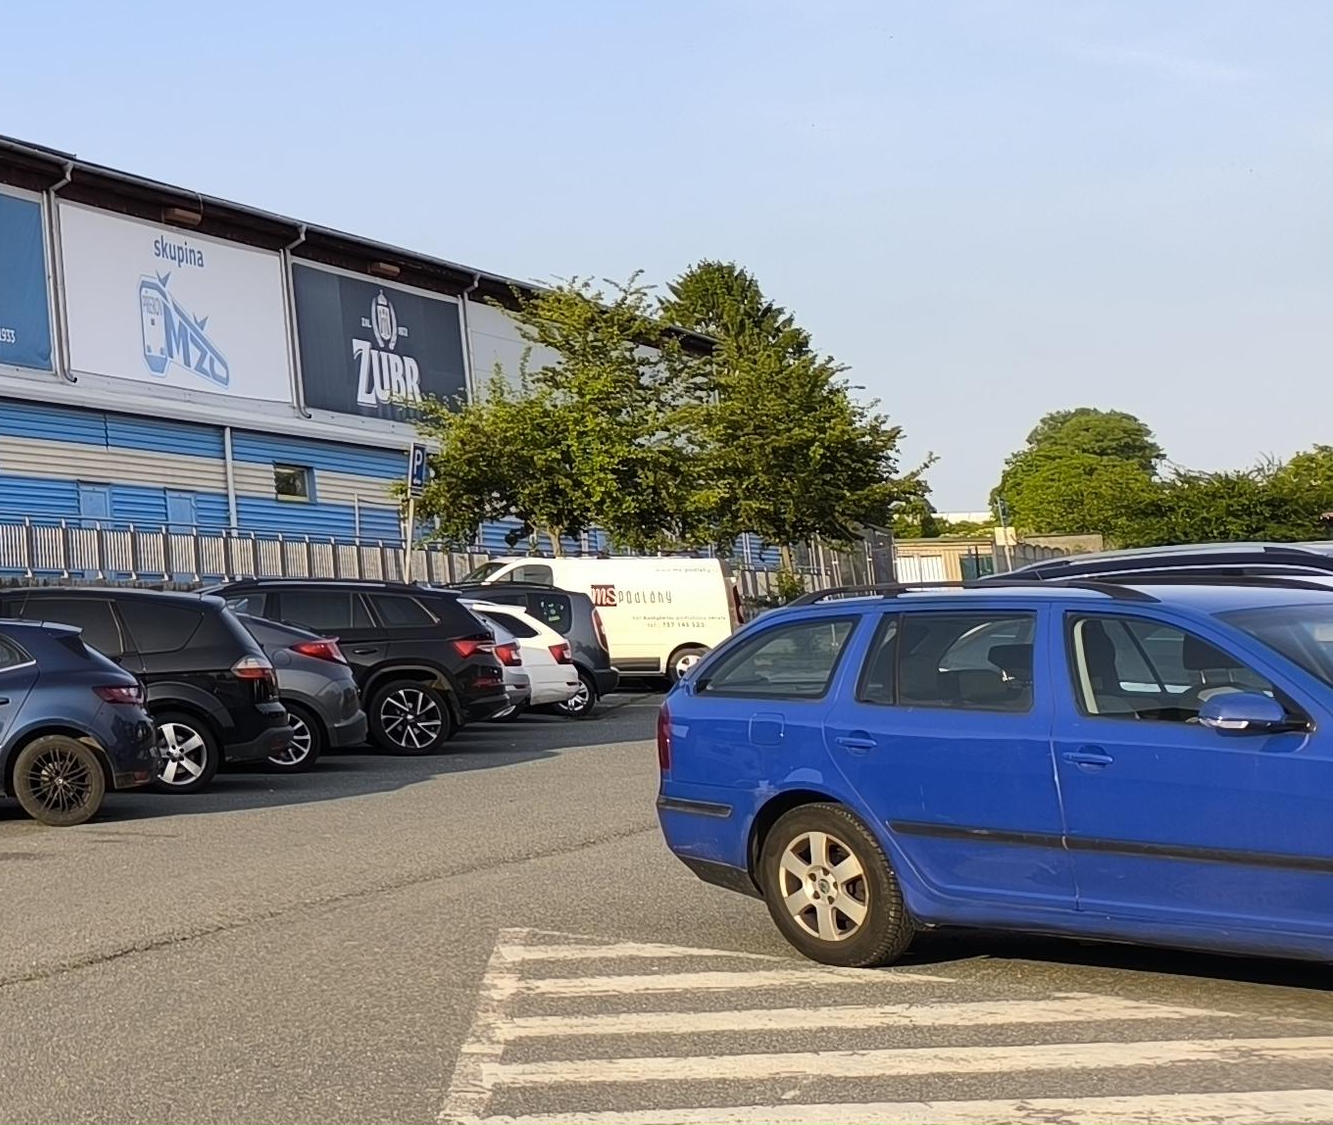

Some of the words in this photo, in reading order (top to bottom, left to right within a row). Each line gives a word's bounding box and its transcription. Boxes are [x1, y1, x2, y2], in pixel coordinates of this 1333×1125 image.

[153, 235, 205, 269] skupina
[352, 339, 424, 410] ZUBR
[414, 449, 423, 475] P
